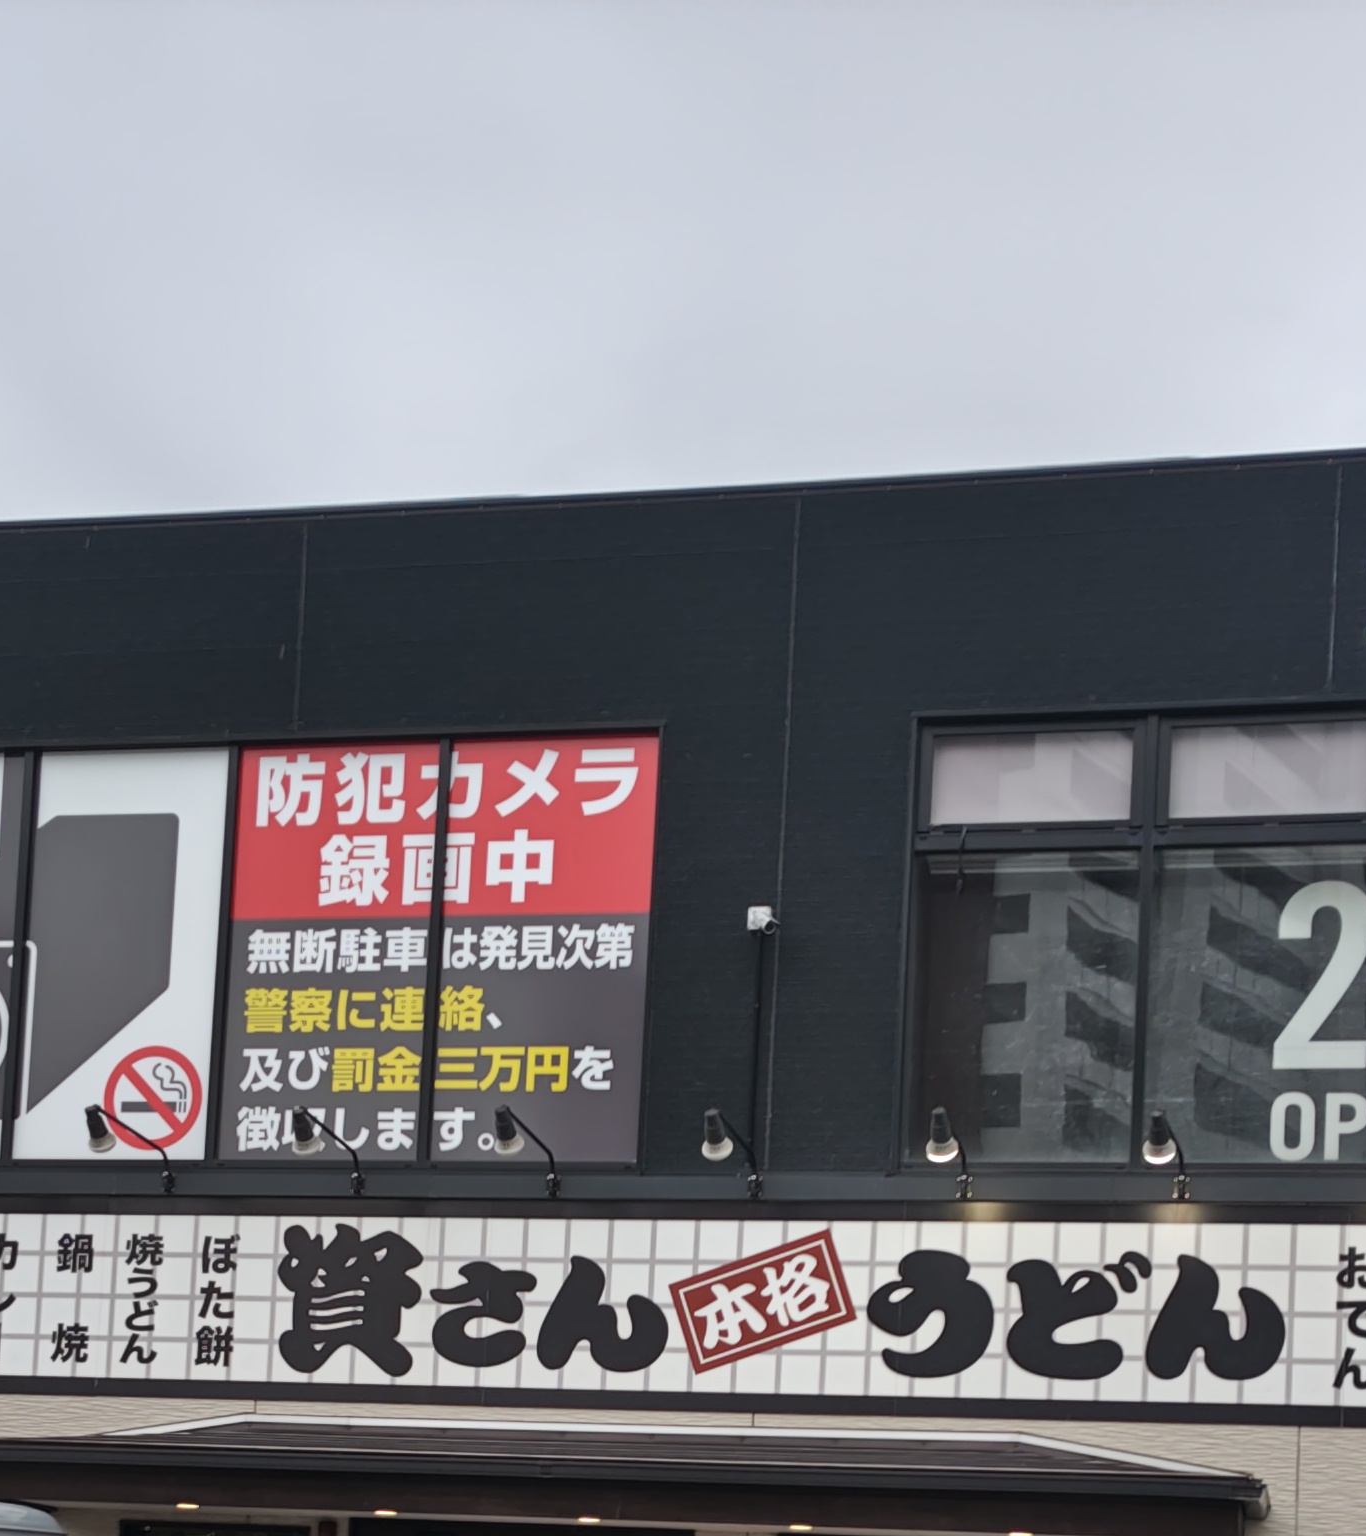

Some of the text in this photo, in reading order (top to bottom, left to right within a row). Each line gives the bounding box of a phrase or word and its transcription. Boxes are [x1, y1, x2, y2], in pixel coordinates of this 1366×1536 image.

[255, 748, 639, 828] 防犯カメラ
[318, 829, 554, 907] 録画中
[247, 923, 636, 975] 無断駐車は発見次第
[244, 985, 503, 1033] 警察に連絡、
[239, 1045, 615, 1092] 及び罰金三万円を
[51, 1233, 94, 1363] 鍋焼
[119, 1234, 164, 1365] 焼うどん
[194, 1233, 241, 1367] ぼた餅
[693, 1253, 831, 1349] 本格
